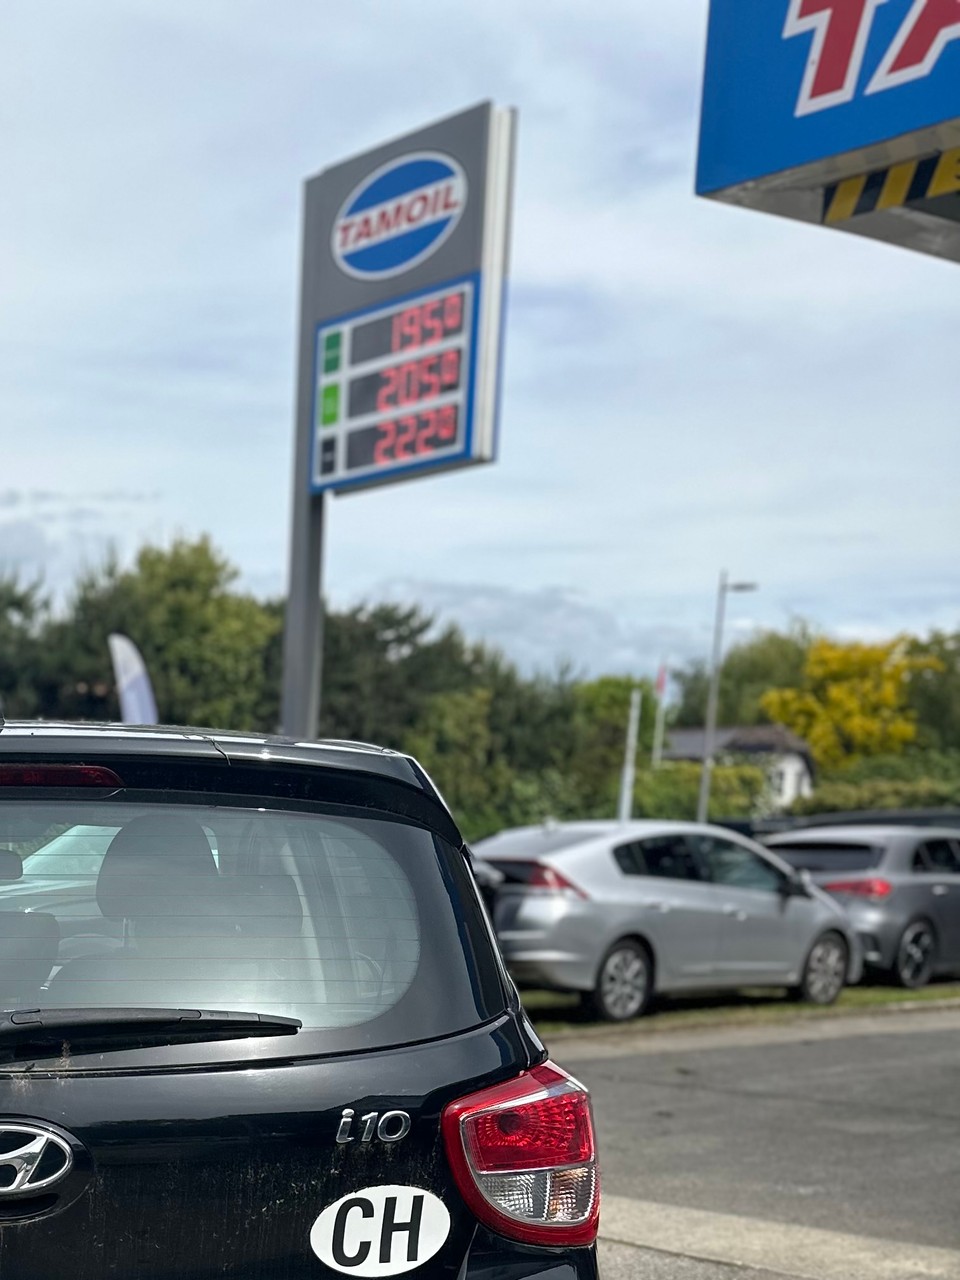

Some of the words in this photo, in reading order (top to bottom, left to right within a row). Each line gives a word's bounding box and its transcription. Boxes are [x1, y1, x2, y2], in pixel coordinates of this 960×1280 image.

[339, 183, 458, 248] TAMOIL
[336, 1108, 412, 1143] i10
[331, 1195, 425, 1267] CH
